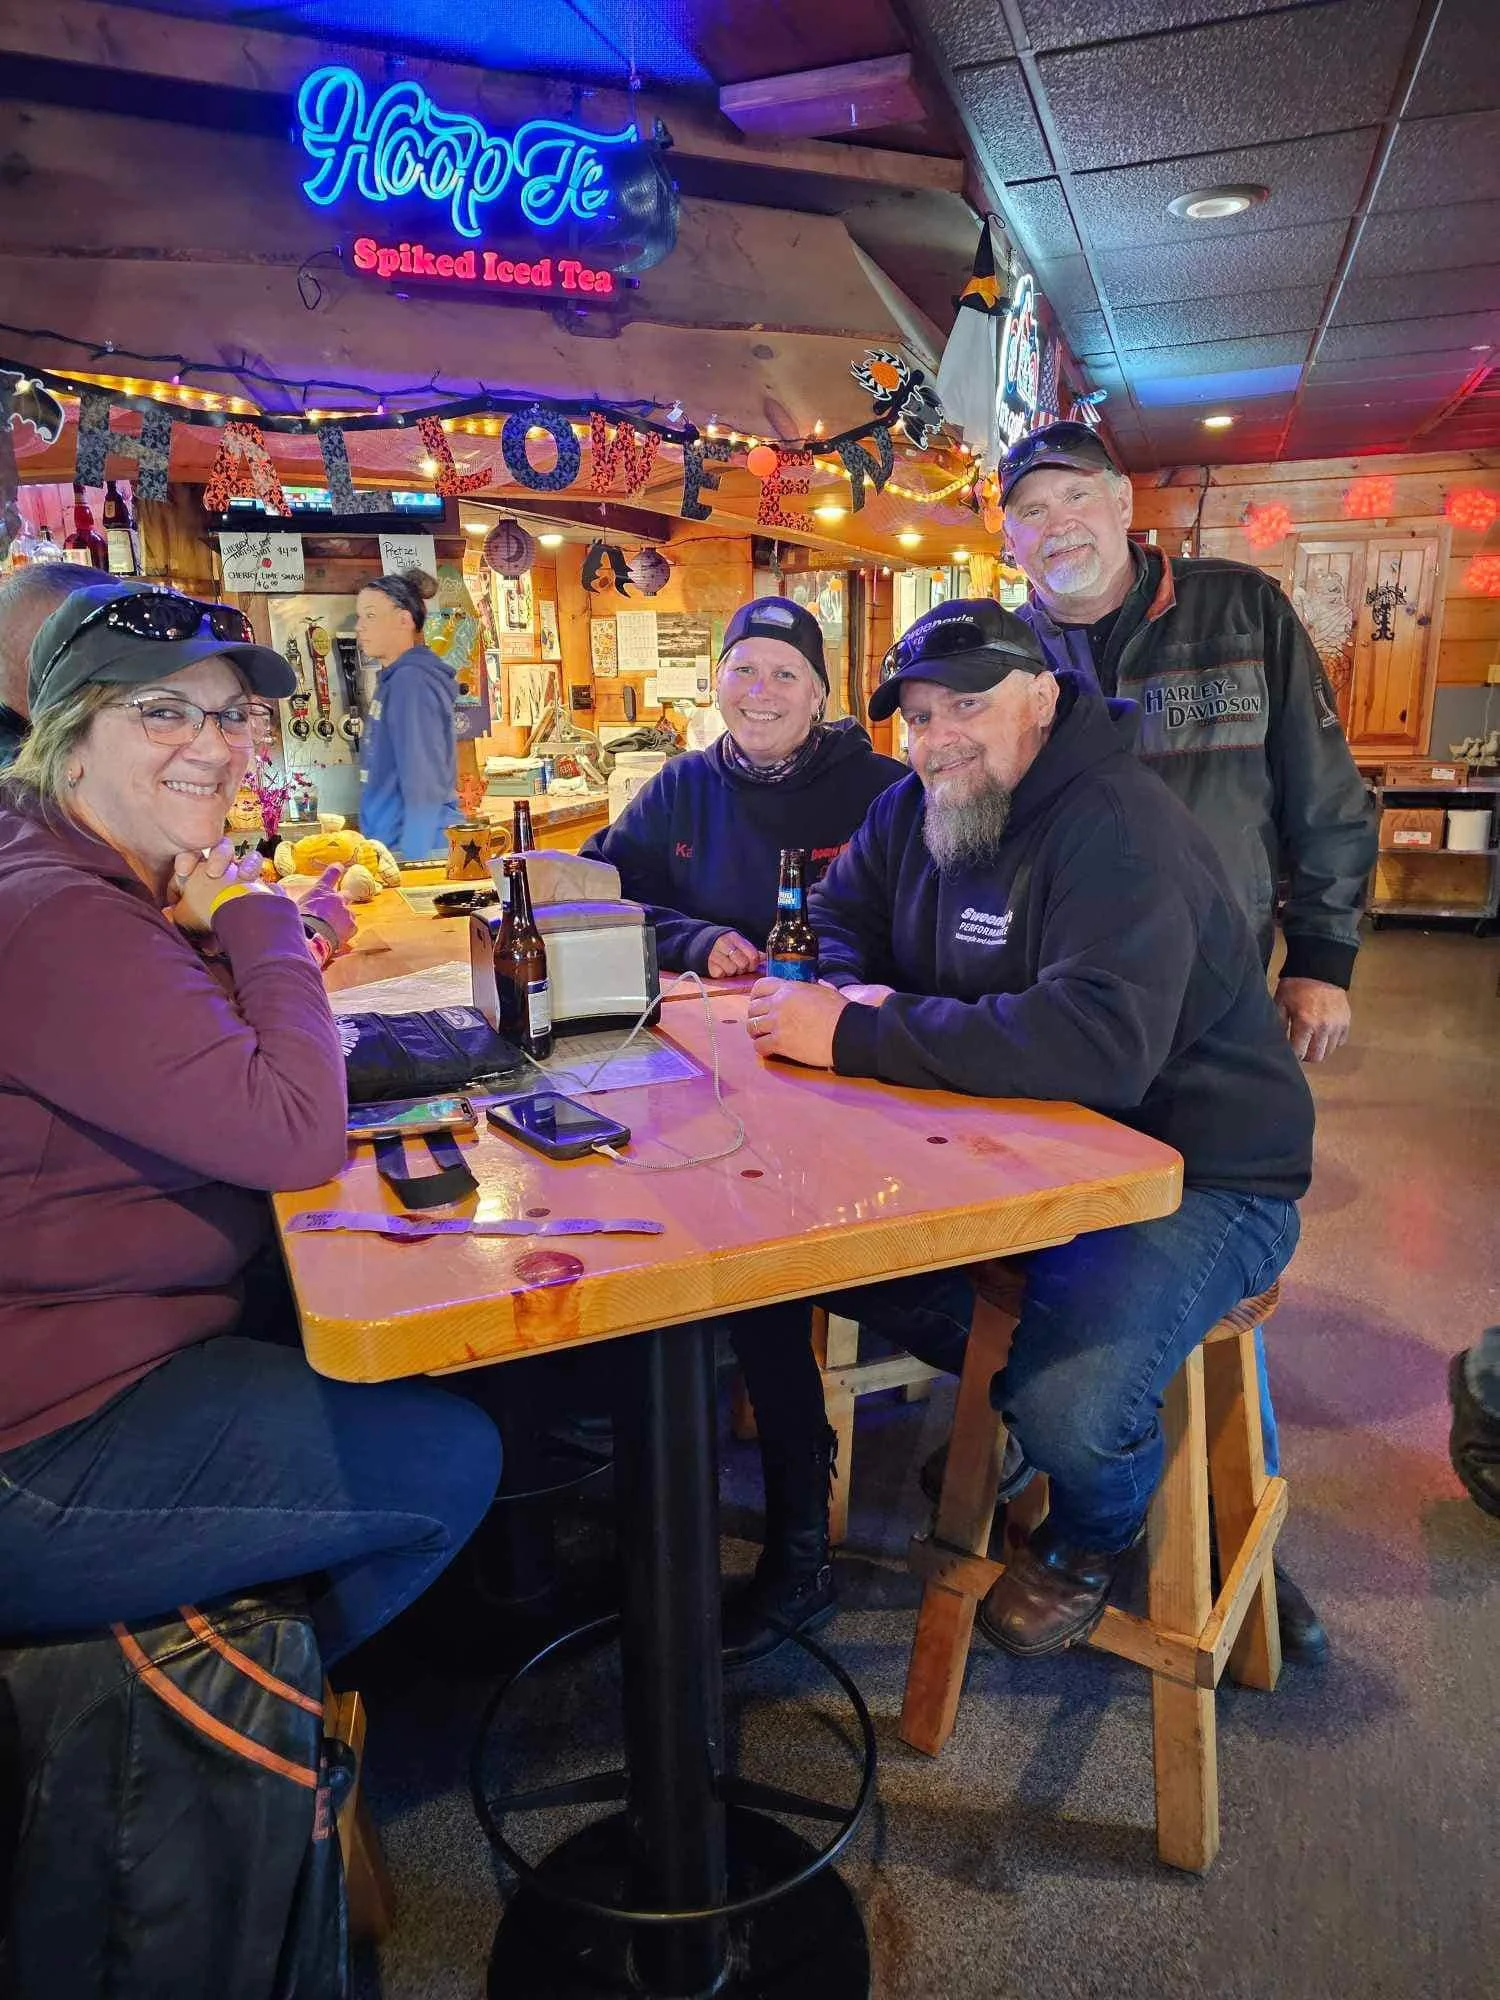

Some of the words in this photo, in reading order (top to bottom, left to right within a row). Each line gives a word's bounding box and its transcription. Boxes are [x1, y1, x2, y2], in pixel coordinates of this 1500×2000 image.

[298, 66, 515, 238] Hoop
[512, 119, 637, 226] Te
[353, 237, 477, 280] Spiked
[482, 251, 553, 287] Iced
[558, 259, 613, 293] Tea
[74, 398, 896, 533] HALLOWEEN
[222, 538, 248, 556] CHERRY
[228, 571, 258, 580] CHERRY
[261, 572, 278, 580] LIME
[281, 573, 304, 581] SMASH
[1145, 678, 1238, 715] HARLEY-
[1167, 696, 1261, 730] DAVIDSON
